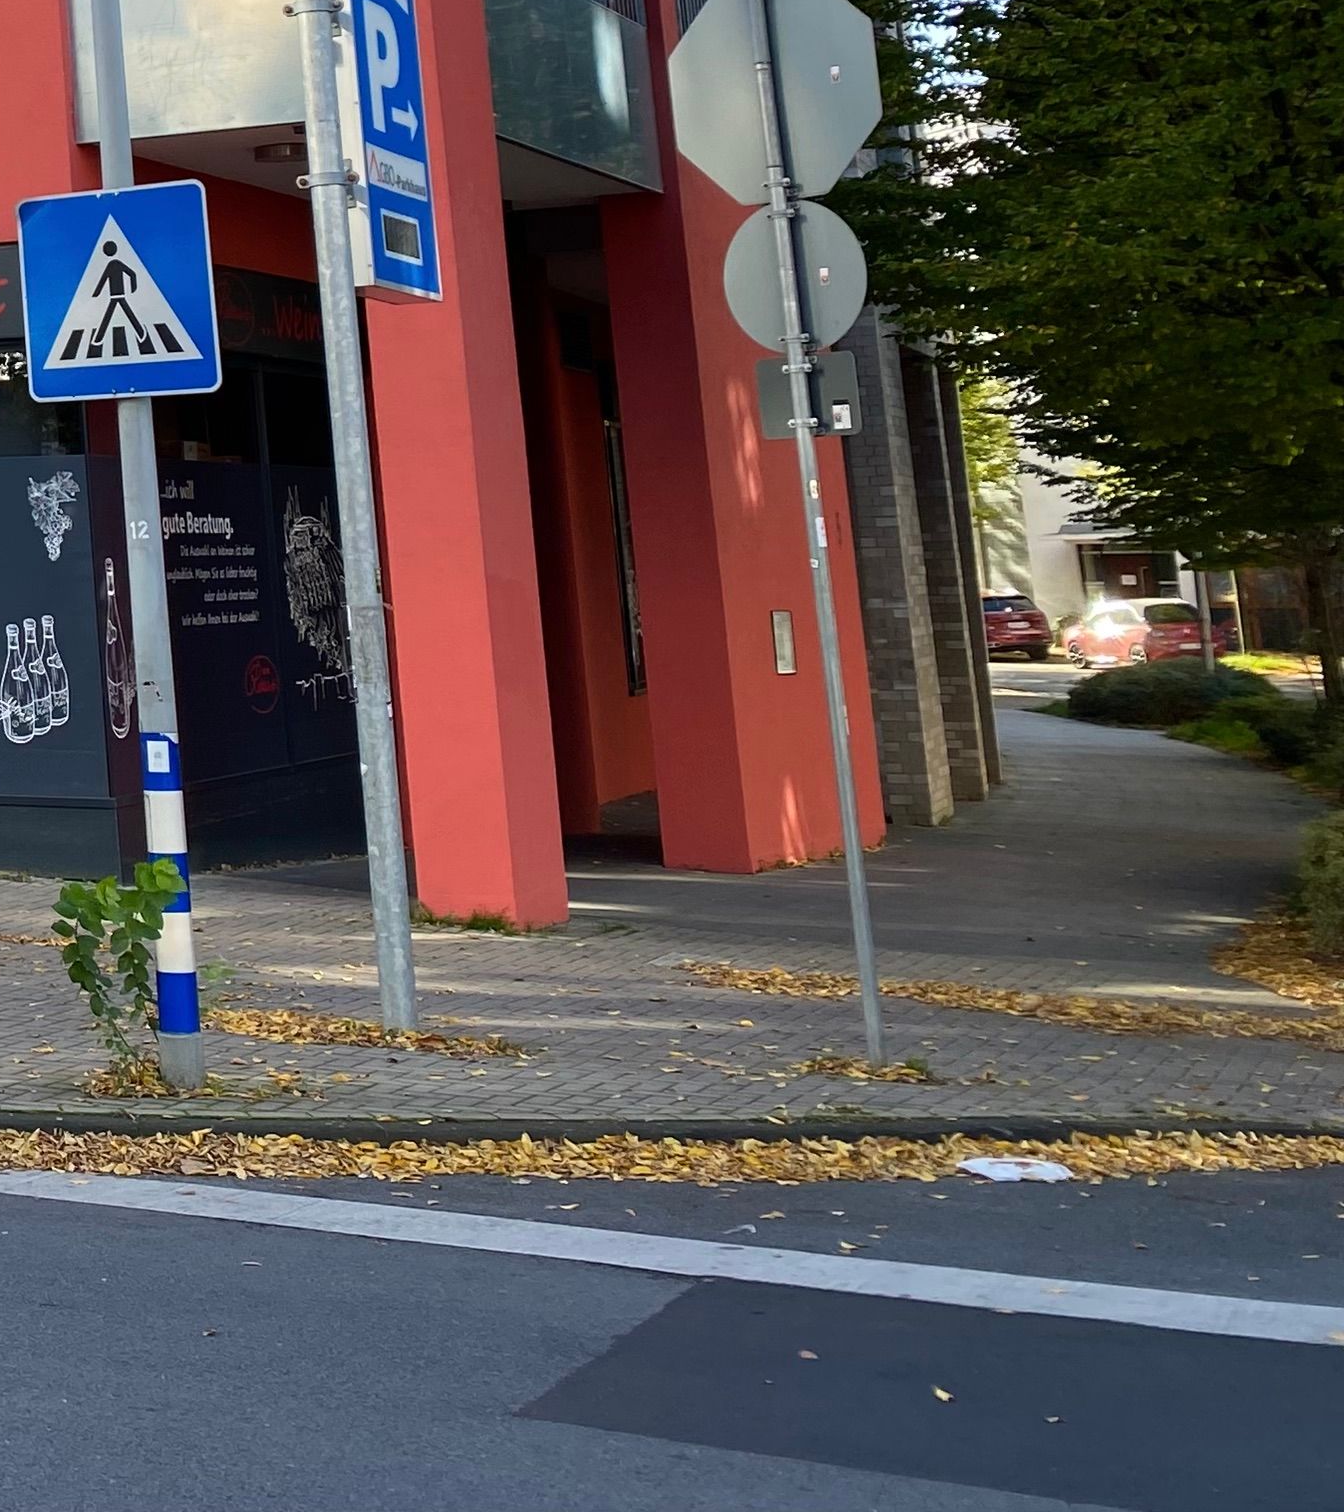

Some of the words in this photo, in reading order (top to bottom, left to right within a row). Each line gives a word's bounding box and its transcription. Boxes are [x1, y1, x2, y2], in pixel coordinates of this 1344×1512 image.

[180, 479, 194, 500] will
[129, 520, 150, 540] 12
[162, 513, 185, 540] gute
[186, 511, 234, 541] Beratung.
